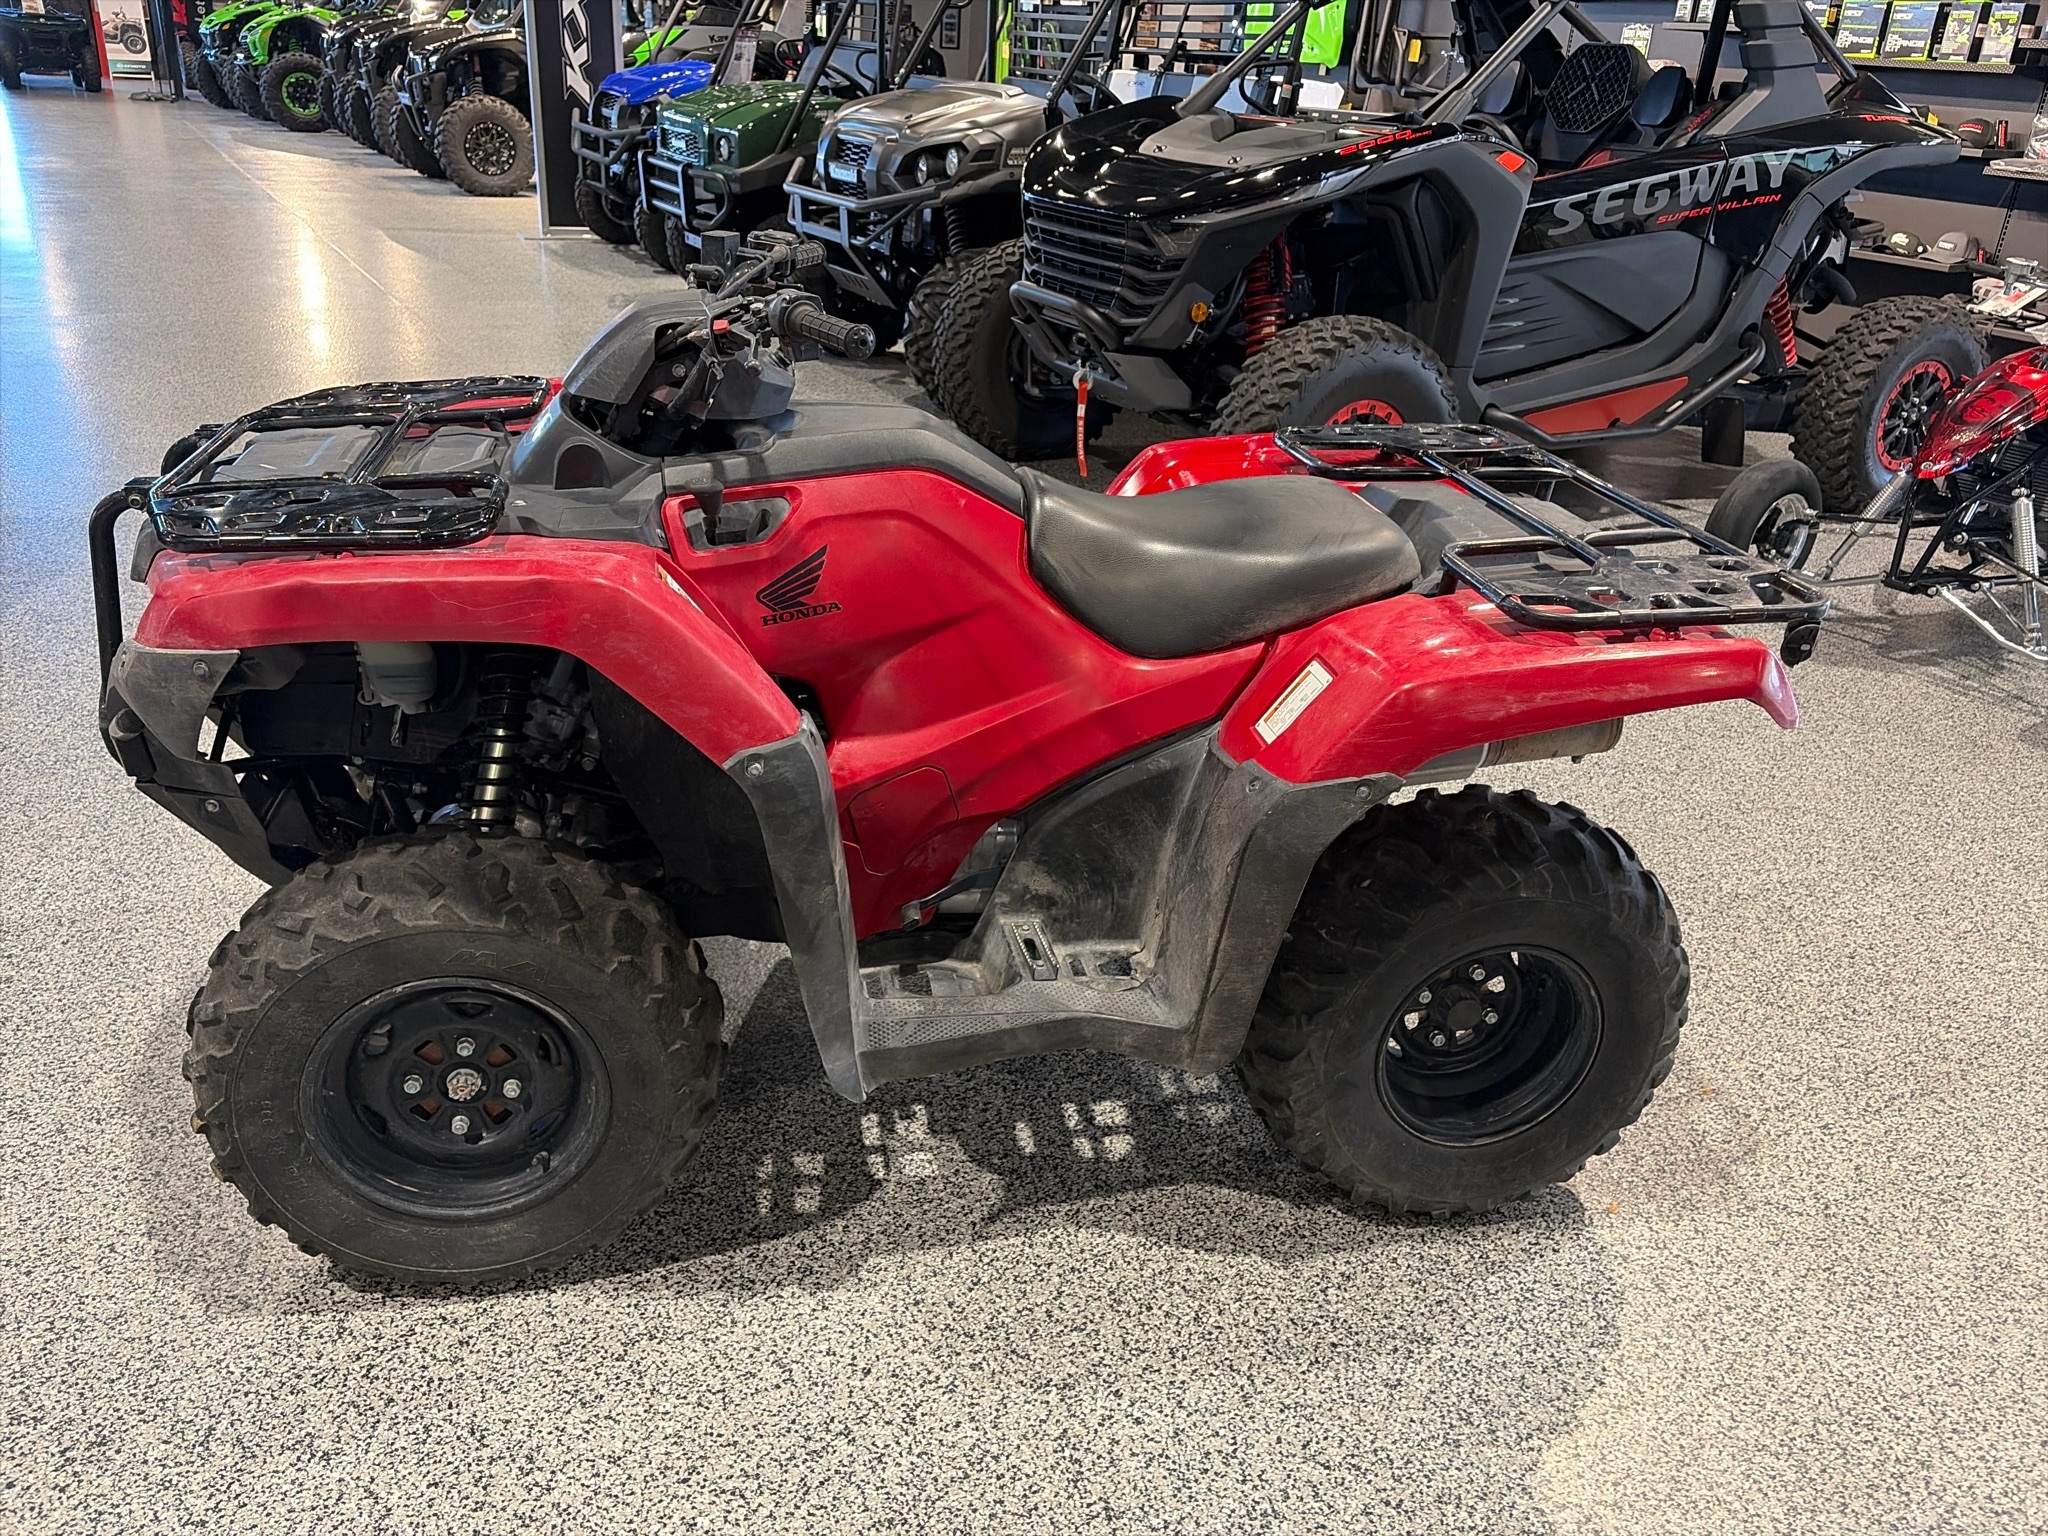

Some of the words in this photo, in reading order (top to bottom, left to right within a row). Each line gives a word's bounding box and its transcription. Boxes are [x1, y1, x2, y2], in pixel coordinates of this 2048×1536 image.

[1548, 148, 1797, 236] SEGWAY
[1656, 206, 1713, 225] SUPER
[1717, 193, 1782, 214] VILLAIN
[760, 602, 842, 627] HONDA
